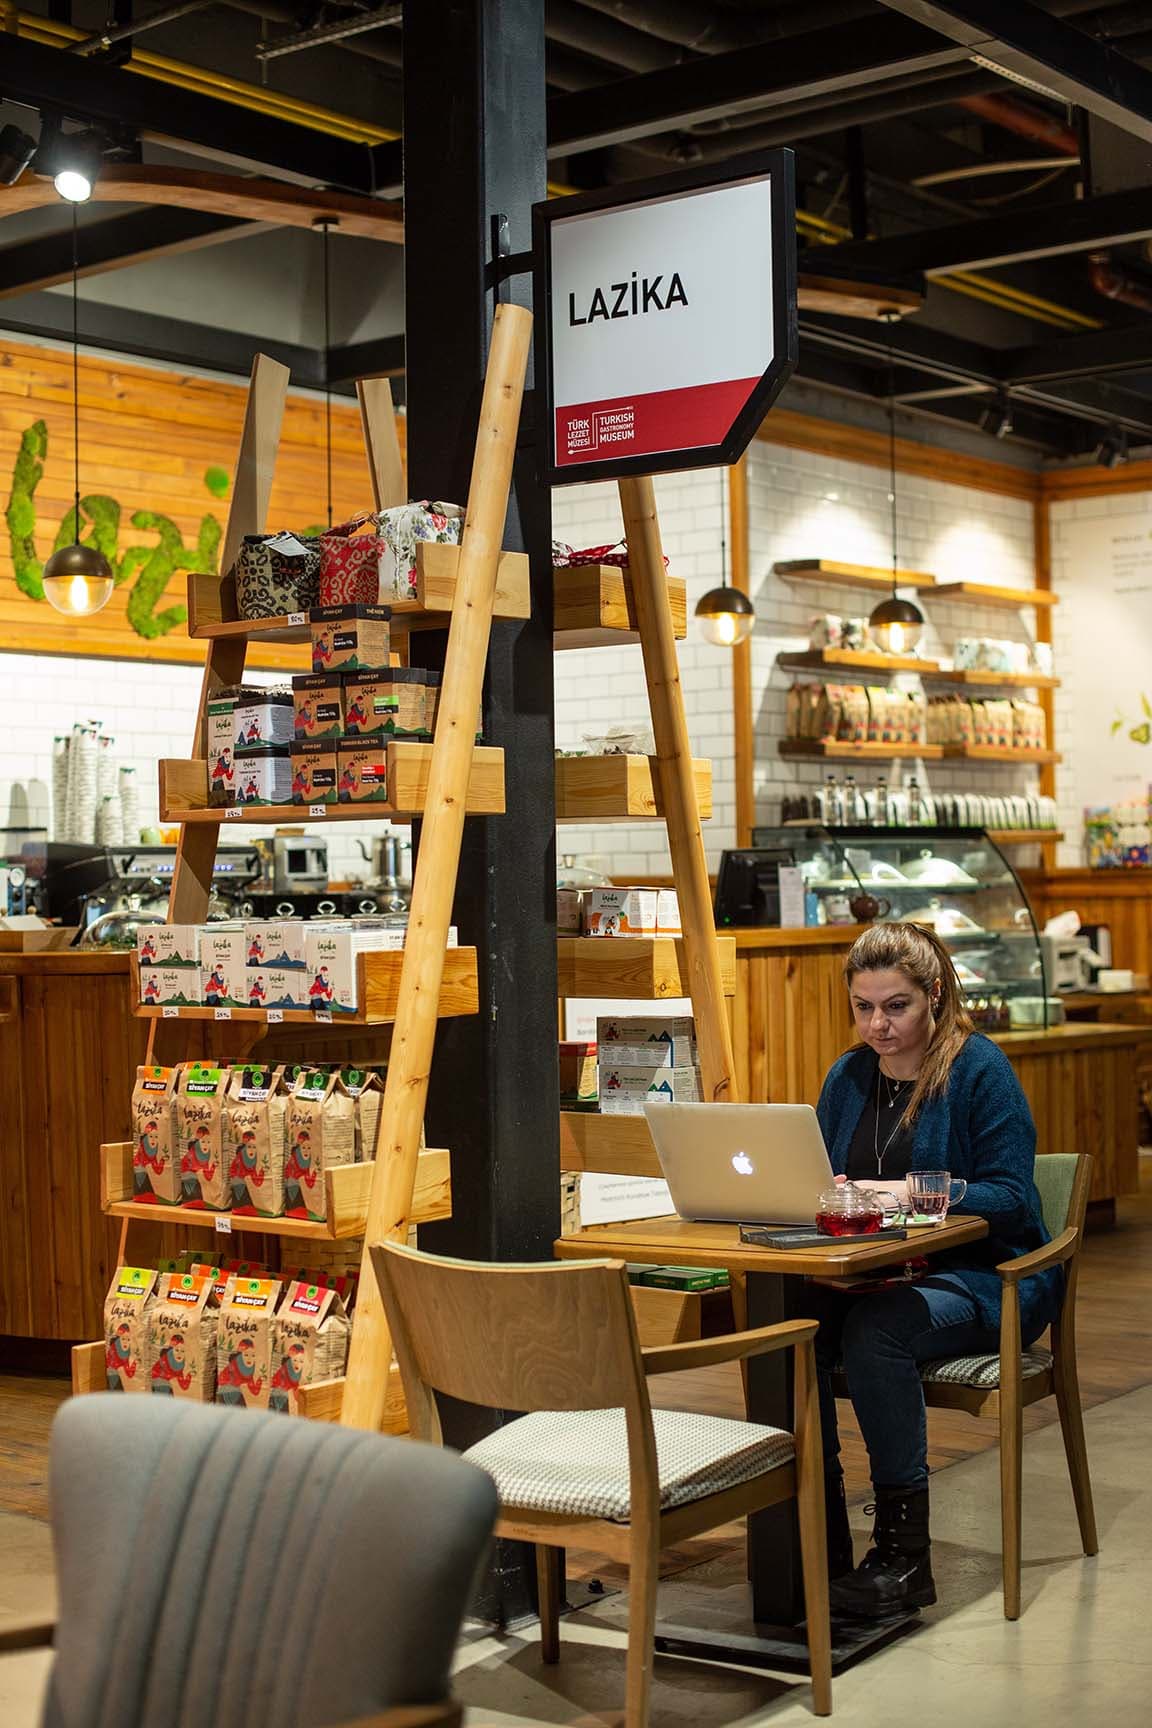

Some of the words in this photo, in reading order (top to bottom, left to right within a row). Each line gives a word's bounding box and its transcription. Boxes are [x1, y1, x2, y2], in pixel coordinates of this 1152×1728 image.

[569, 271, 689, 327] LAZİKA
[568, 419, 590, 431] TÜRK
[600, 412, 634, 425] TURKISH
[568, 437, 590, 448] MÜZESİ
[600, 430, 634, 443] MUSEUM
